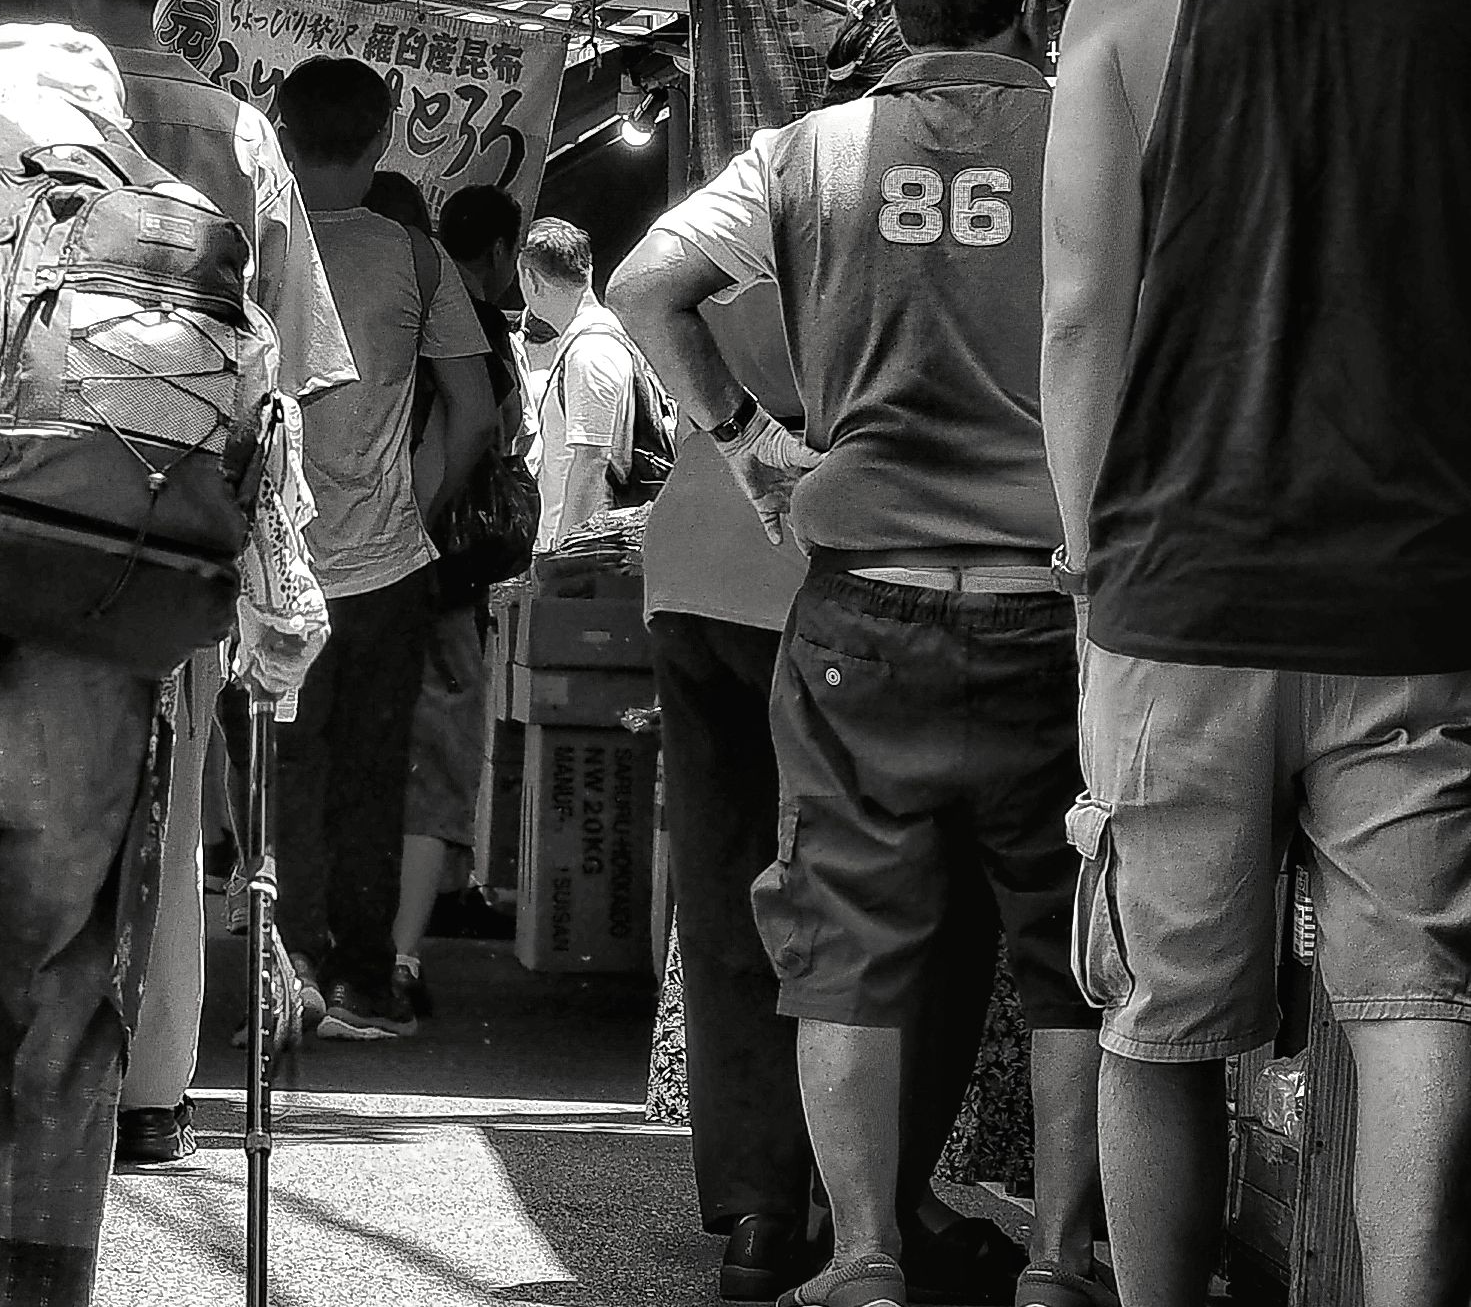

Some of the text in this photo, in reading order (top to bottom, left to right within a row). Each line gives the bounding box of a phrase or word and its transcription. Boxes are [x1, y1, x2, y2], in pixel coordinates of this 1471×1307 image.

[363, 22, 524, 85] 羅臼産昆布
[878, 165, 1013, 246] 86
[581, 748, 606, 875] NW 20KG
